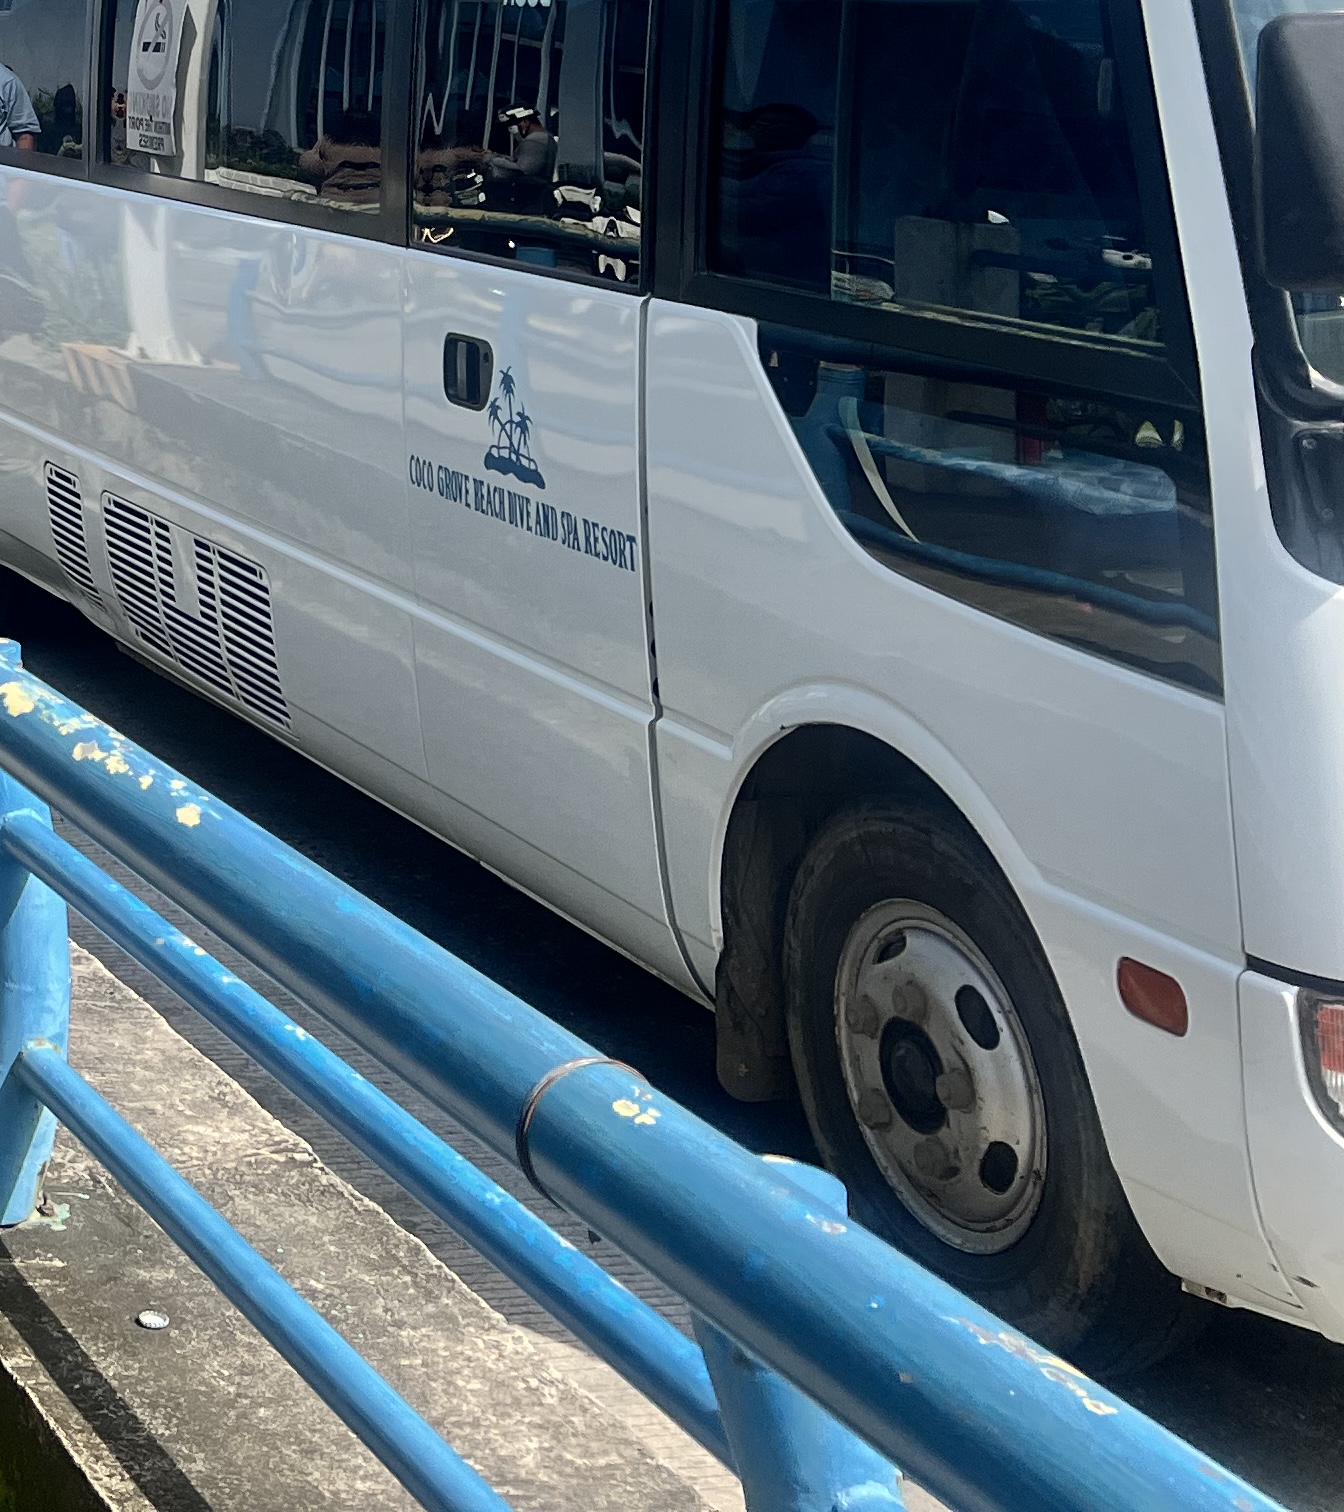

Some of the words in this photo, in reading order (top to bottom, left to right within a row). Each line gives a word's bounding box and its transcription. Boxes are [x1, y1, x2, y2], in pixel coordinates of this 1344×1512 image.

[409, 454, 435, 493] COCO
[436, 464, 472, 509] GROVE
[472, 477, 506, 523] BEACH
[506, 489, 533, 533] DIVE
[534, 500, 559, 542] AND
[560, 510, 582, 553] SPA
[582, 517, 637, 573] RESORT
